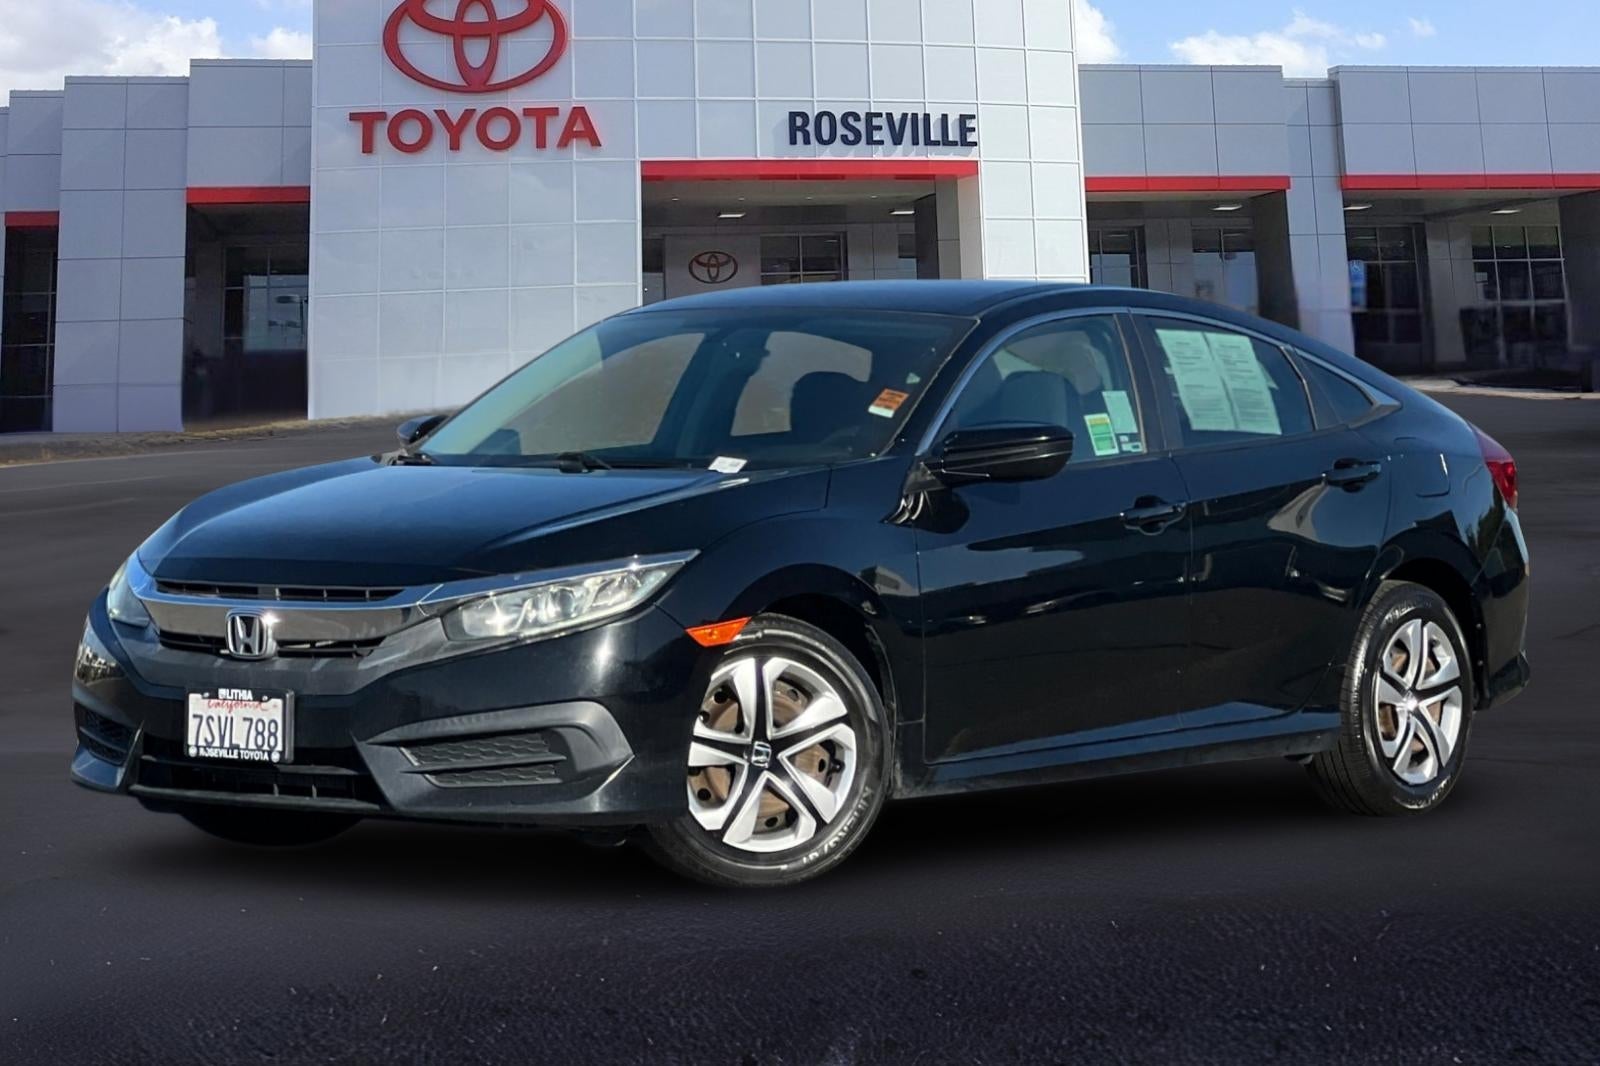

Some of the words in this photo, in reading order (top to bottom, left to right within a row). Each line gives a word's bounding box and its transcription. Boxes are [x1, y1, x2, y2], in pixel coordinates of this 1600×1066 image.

[349, 106, 602, 154] TOYOTA
[788, 110, 978, 147] ROSEVILLE
[226, 688, 253, 701] LITHIA
[240, 750, 269, 761] TOYOTA
